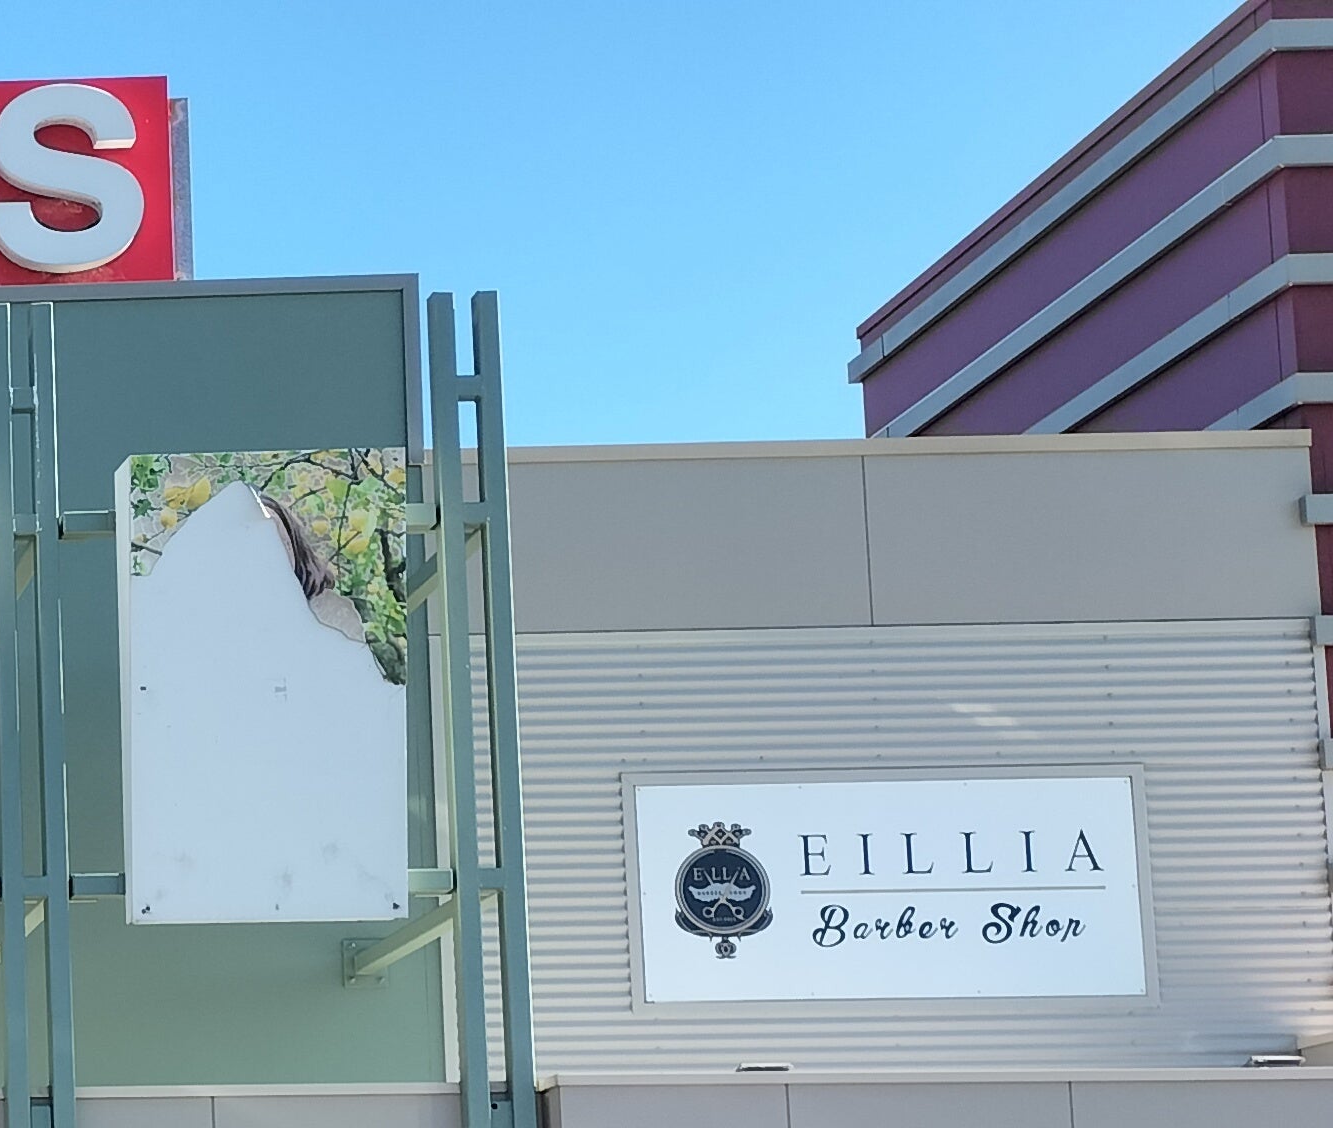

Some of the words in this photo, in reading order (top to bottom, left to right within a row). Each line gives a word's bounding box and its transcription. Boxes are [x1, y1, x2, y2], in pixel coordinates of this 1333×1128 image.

[797, 829, 1104, 877] EILLIA
[812, 904, 958, 947] Barber
[982, 903, 1086, 943] Shop
